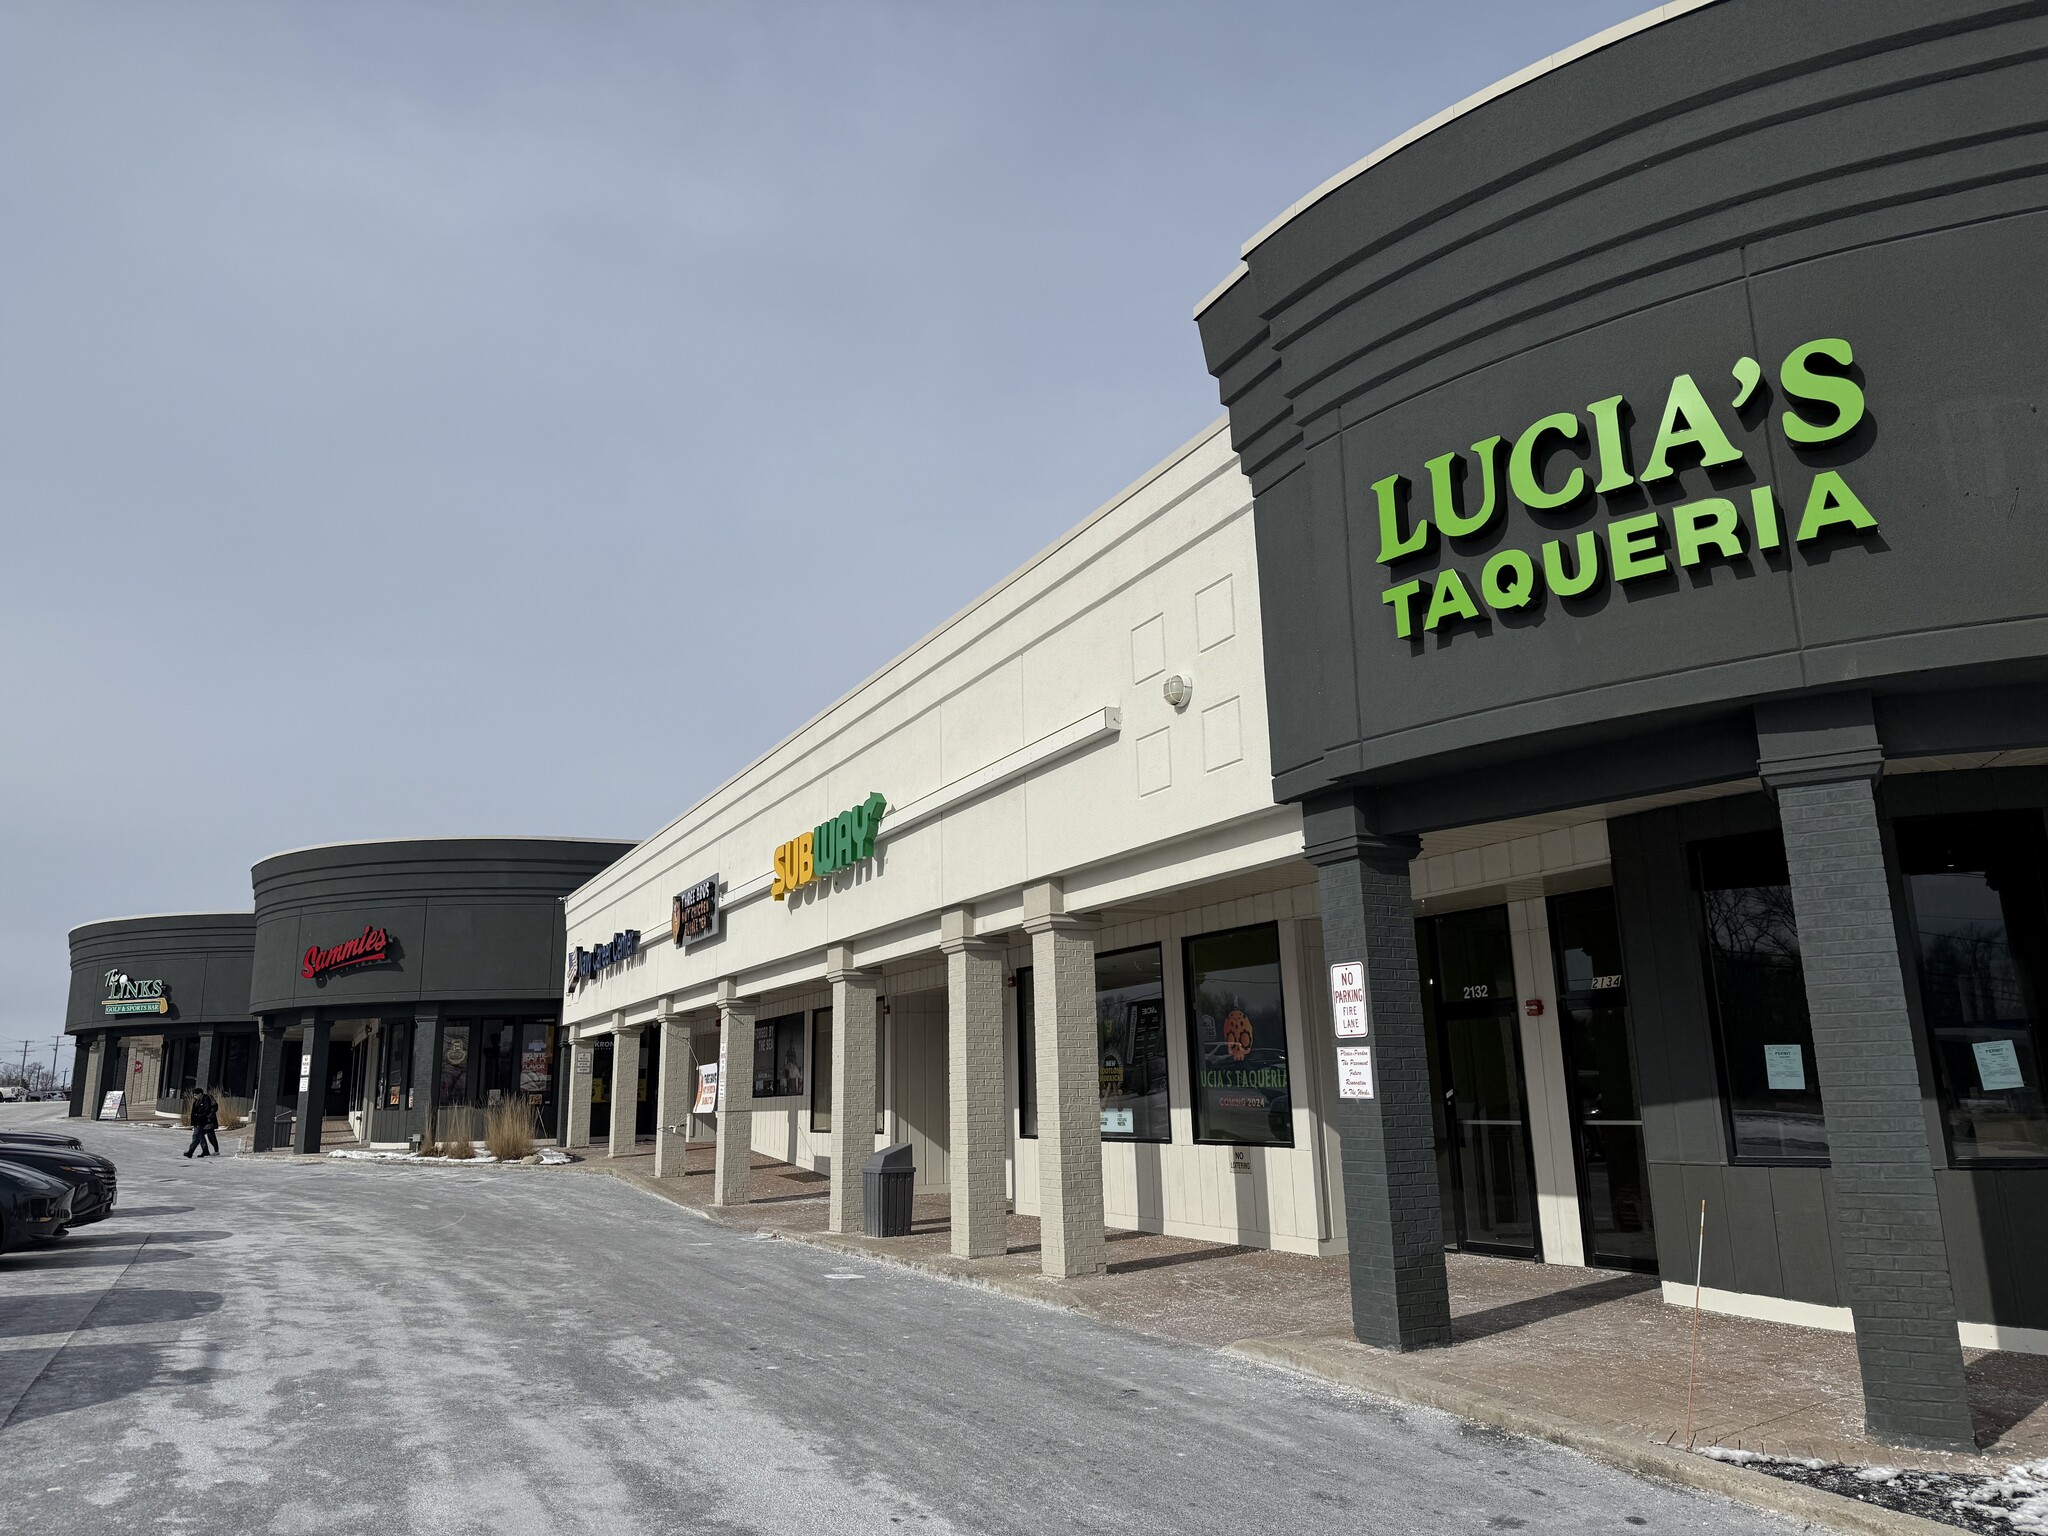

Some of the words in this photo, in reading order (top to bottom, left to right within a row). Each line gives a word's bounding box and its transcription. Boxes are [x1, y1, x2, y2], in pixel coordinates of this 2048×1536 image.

[1371, 338, 1865, 564] LUCIA'S
[1381, 470, 1880, 640] TAQUERIA
[771, 792, 887, 901] SUBWAY
[681, 890, 695, 908] THREE
[301, 925, 387, 979] Sammies
[578, 947, 592, 979] Navy
[593, 944, 612, 971] Career
[613, 931, 634, 962] Center
[104, 968, 120, 987] The
[1341, 972, 1354, 986] NO
[1592, 976, 1621, 989] 2134
[108, 979, 162, 999] LINKS
[1335, 988, 1363, 1004] PARKING
[1463, 985, 1488, 999] 2132
[106, 1005, 120, 1013] GOLF
[126, 1004, 147, 1012] SPORTS
[148, 1003, 159, 1011] BAR
[1342, 1006, 1357, 1016] FIRE
[1343, 1018, 1359, 1029] LANE
[1201, 1069, 1233, 1088] UCIA'S
[1220, 1098, 1245, 1108] COMING
[1247, 1098, 1265, 1108] 2024
[1235, 1151, 1244, 1160] NO
